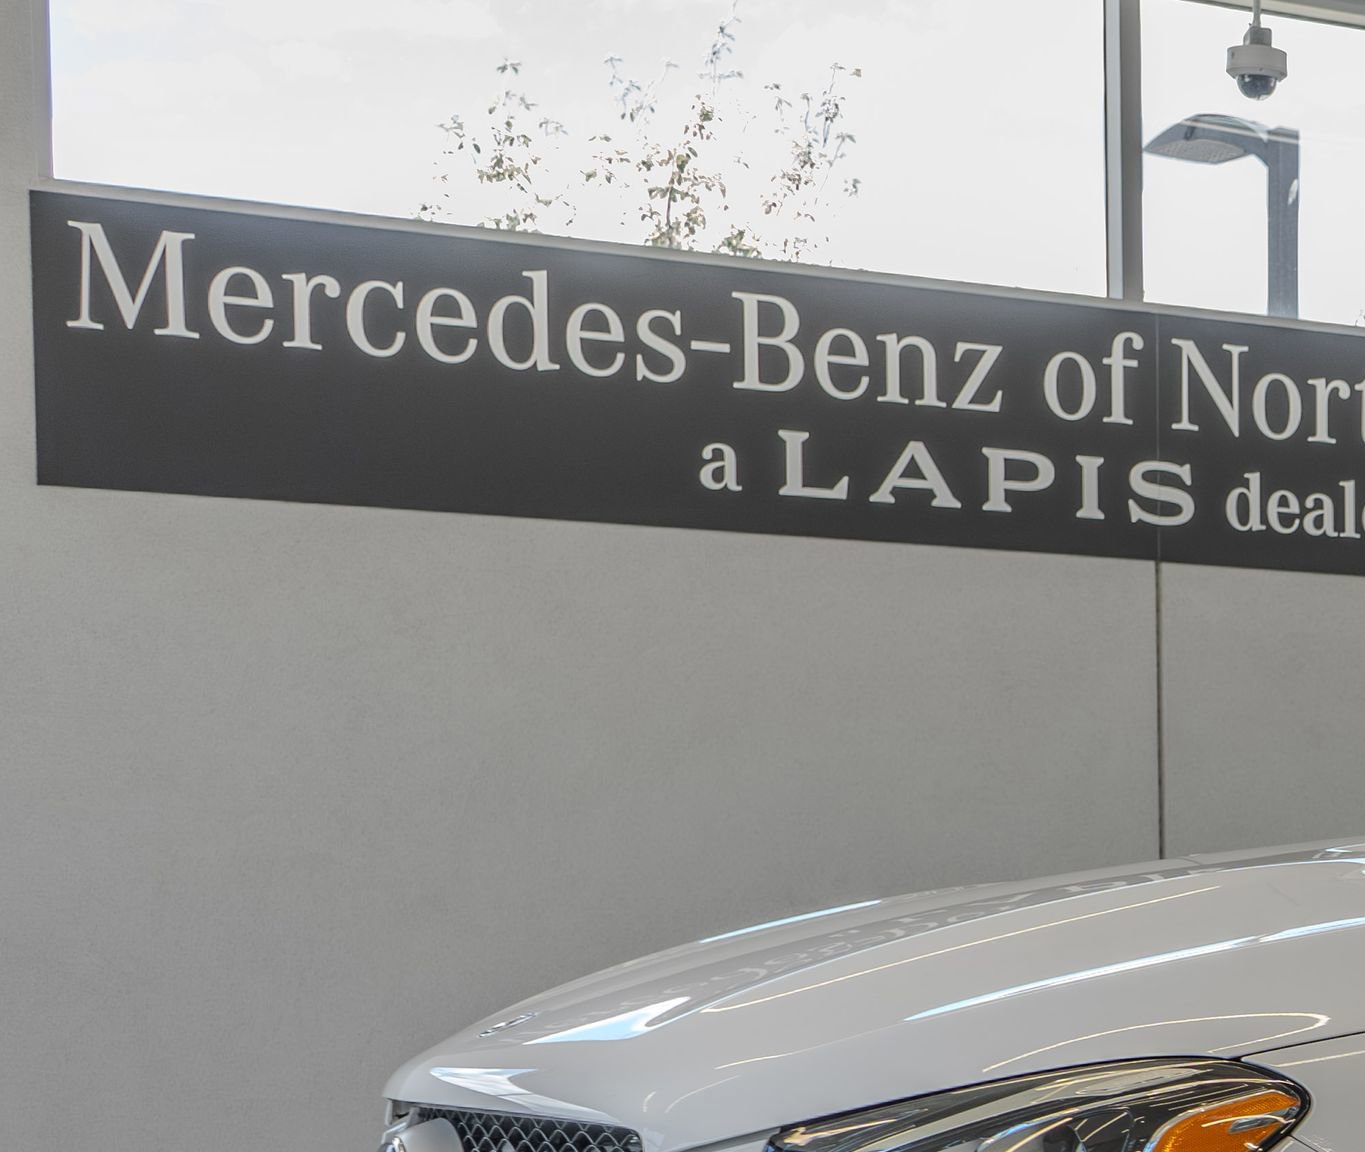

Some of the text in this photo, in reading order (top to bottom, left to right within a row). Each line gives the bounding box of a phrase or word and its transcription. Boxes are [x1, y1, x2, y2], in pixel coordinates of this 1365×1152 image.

[65, 219, 1004, 414] Mercedes-Benz
[1043, 331, 1145, 426] of
[699, 442, 743, 493] a
[777, 429, 1196, 527] LAPIS
